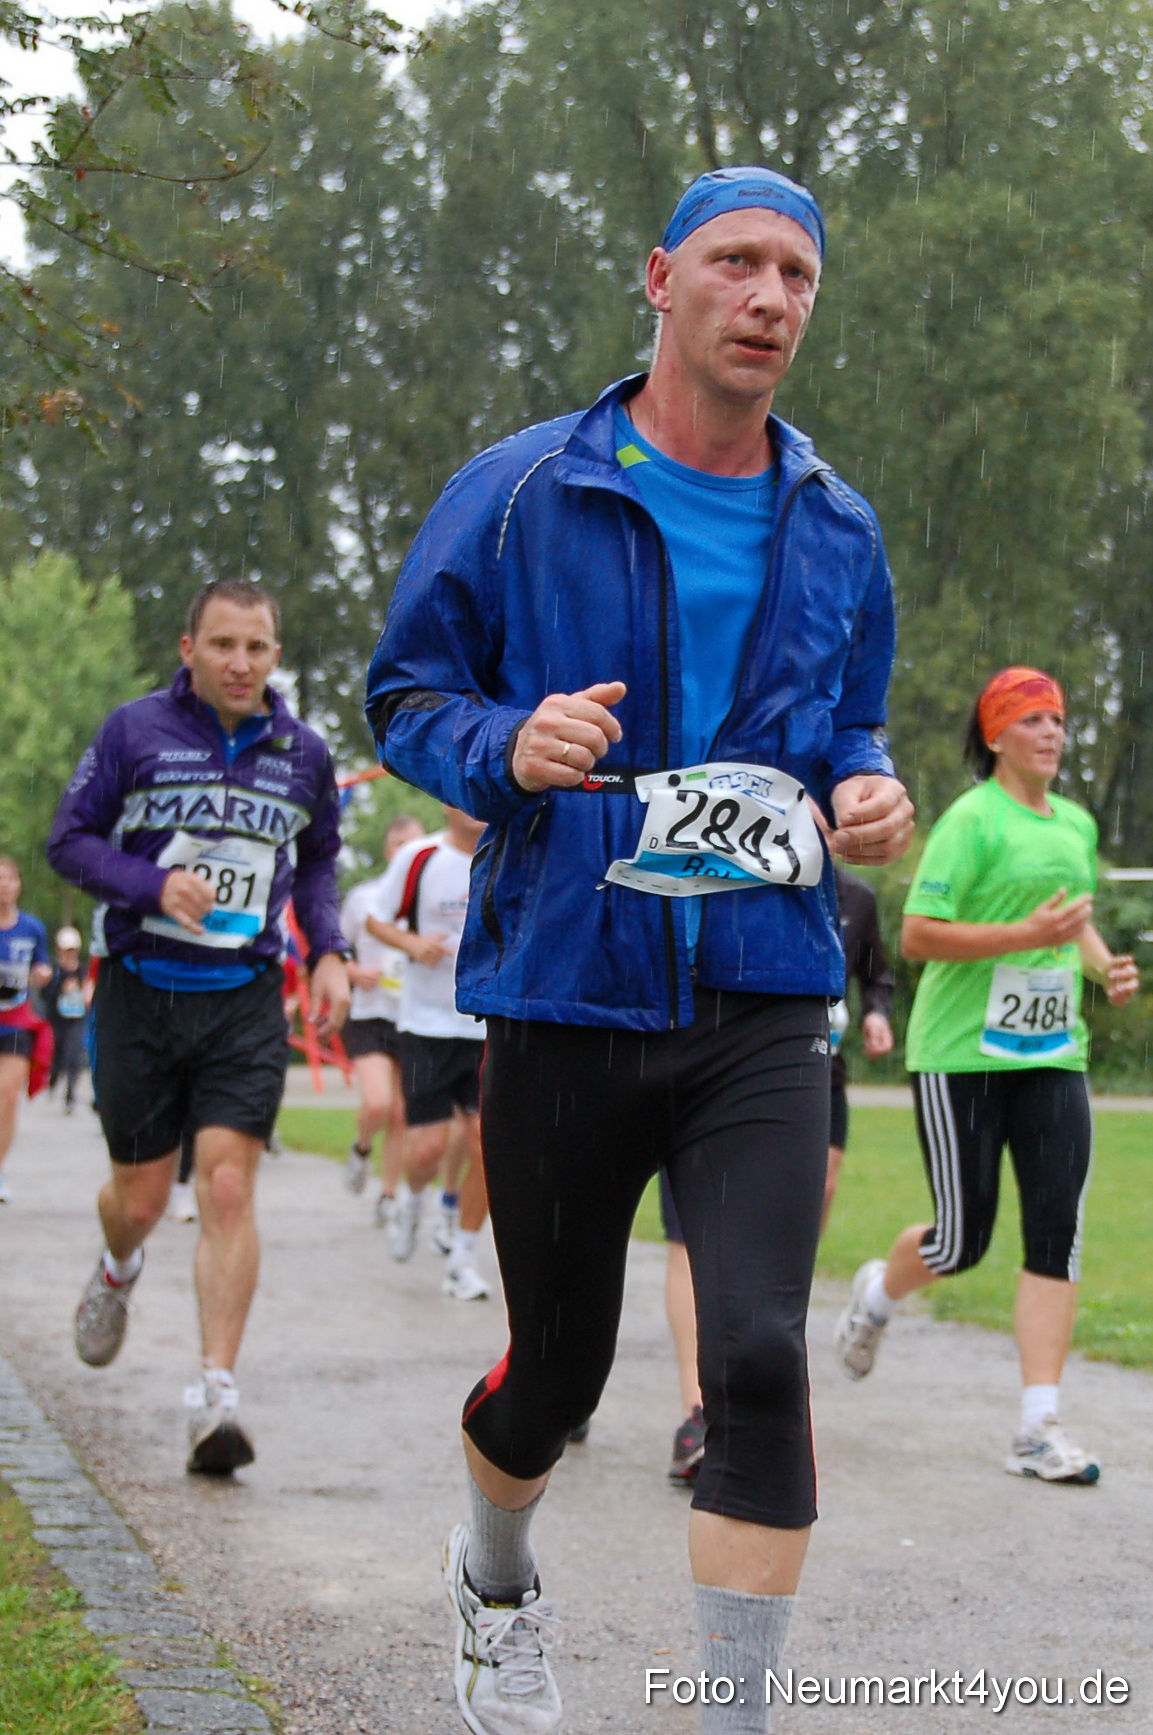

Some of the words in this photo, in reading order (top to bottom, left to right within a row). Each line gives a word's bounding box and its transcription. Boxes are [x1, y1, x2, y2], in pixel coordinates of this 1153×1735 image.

[145, 795, 298, 838] MARIN
[665, 789, 801, 884] 2841
[999, 993, 1068, 1030] 2484
